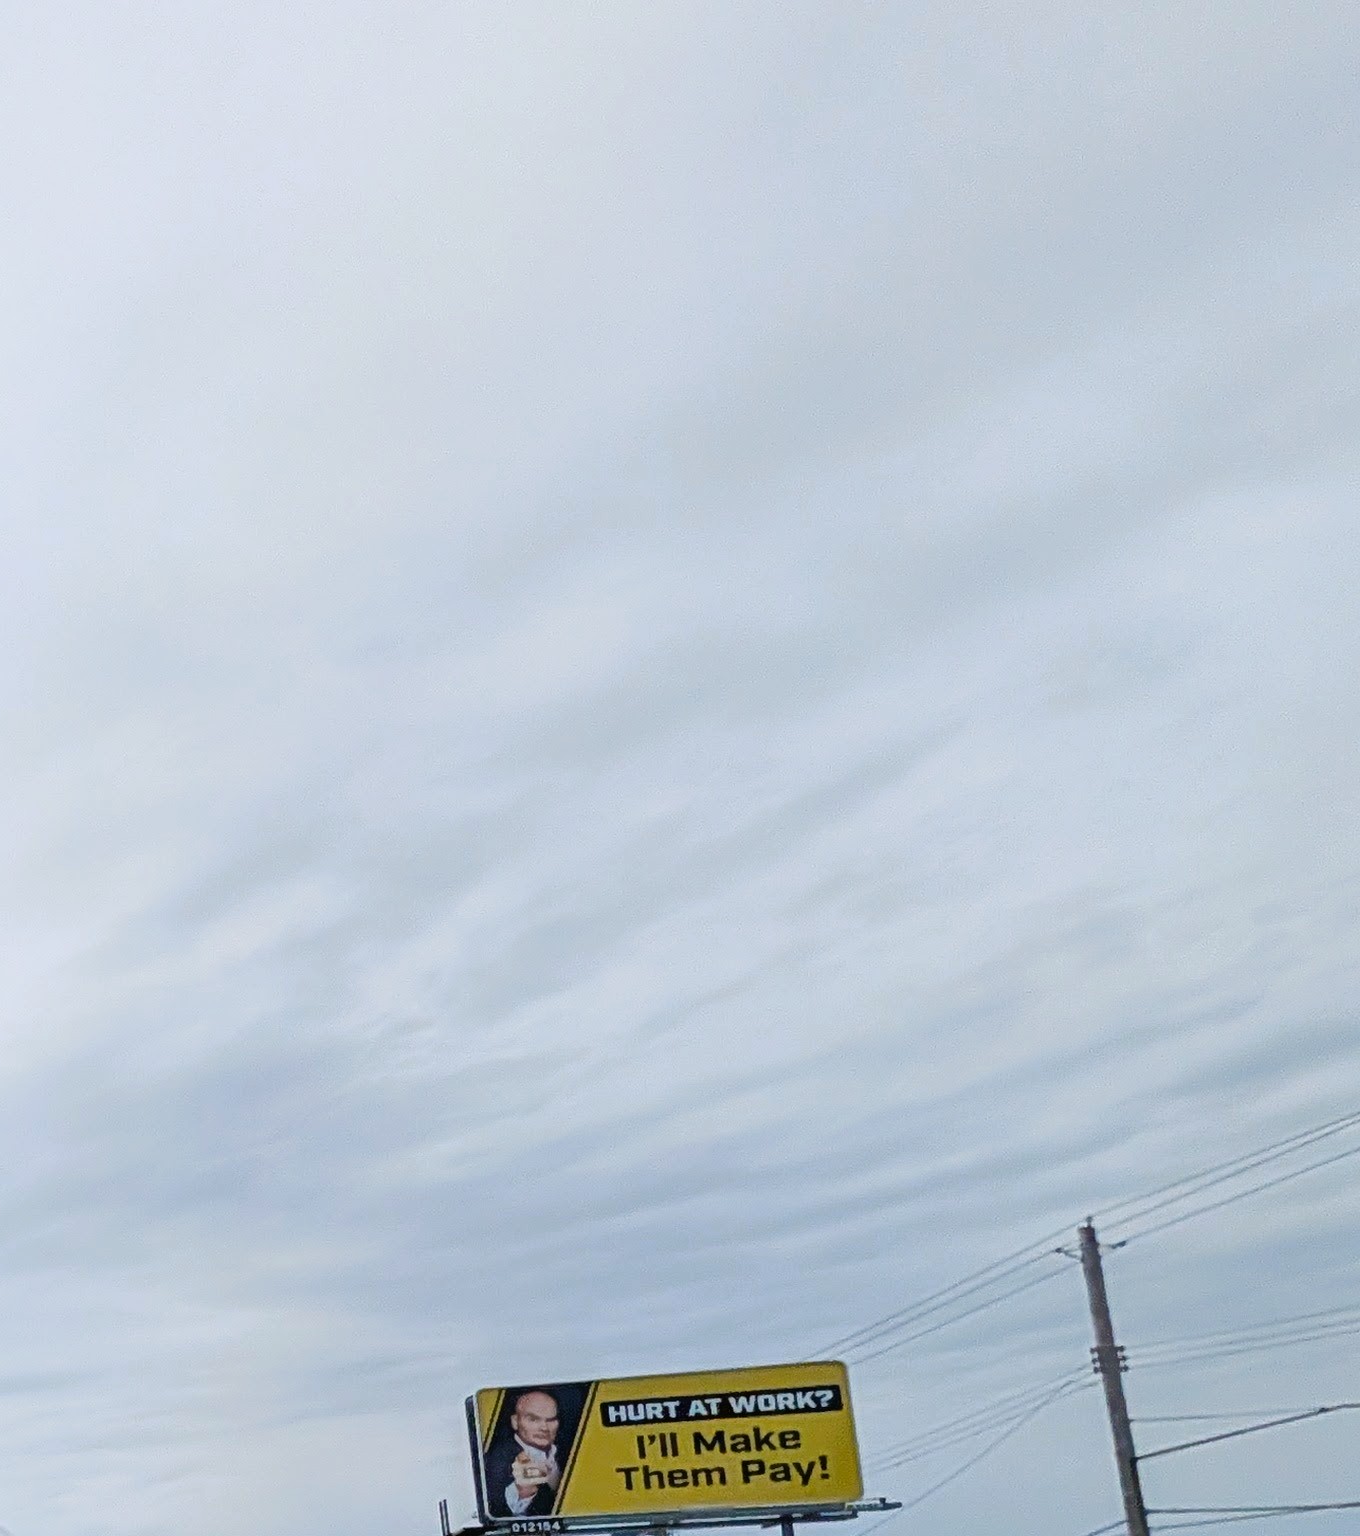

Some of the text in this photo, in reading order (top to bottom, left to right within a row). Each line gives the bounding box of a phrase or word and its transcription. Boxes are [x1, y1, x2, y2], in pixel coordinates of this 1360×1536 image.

[608, 1389, 834, 1424] HURT AT WORK?
[636, 1426, 802, 1460] I'll Make
[615, 1454, 831, 1491] Them Pay!
